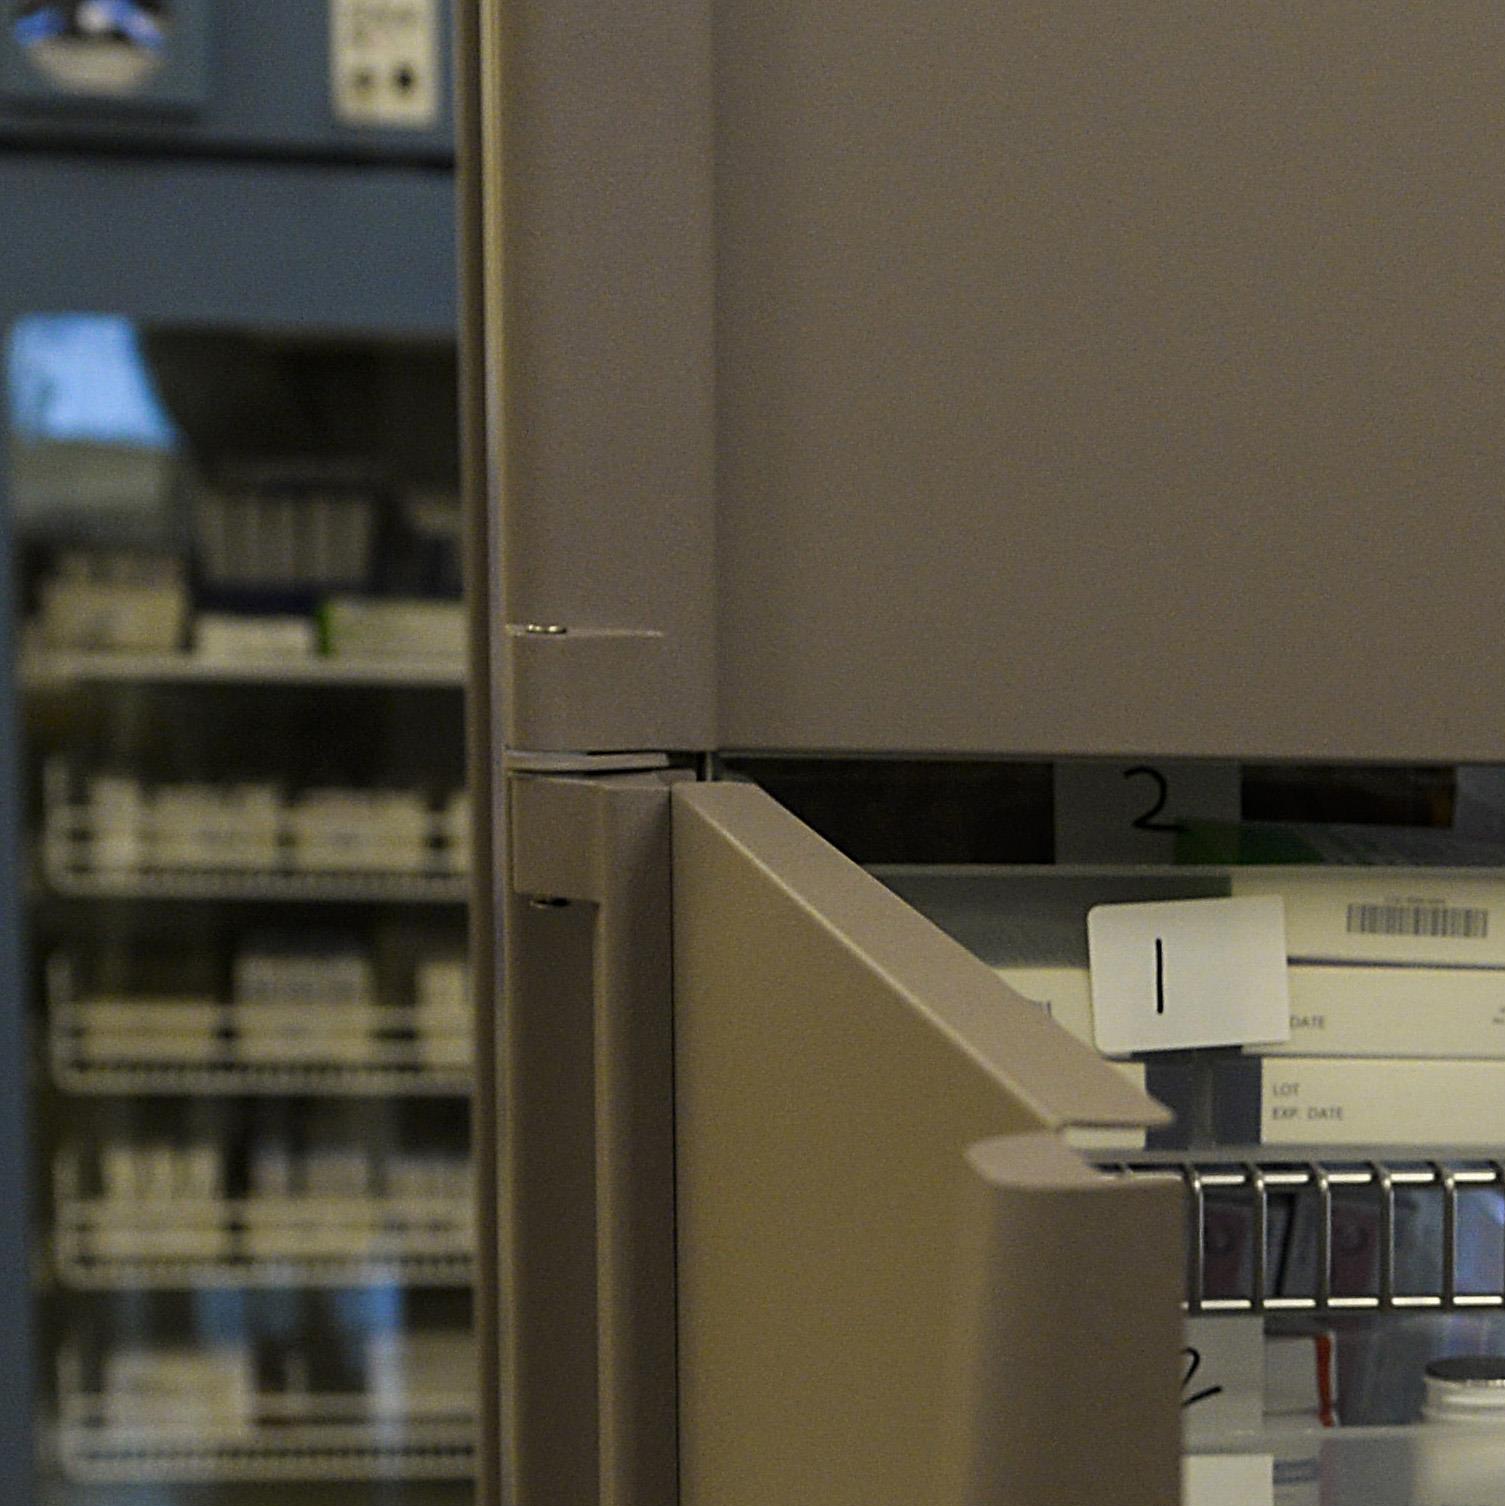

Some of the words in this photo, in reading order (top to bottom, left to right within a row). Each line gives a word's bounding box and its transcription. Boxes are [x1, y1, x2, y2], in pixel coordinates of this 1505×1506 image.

[1123, 767, 1182, 833] 2
[1290, 1015, 1325, 1028] DATE
[1308, 1107, 1343, 1120] DATE
